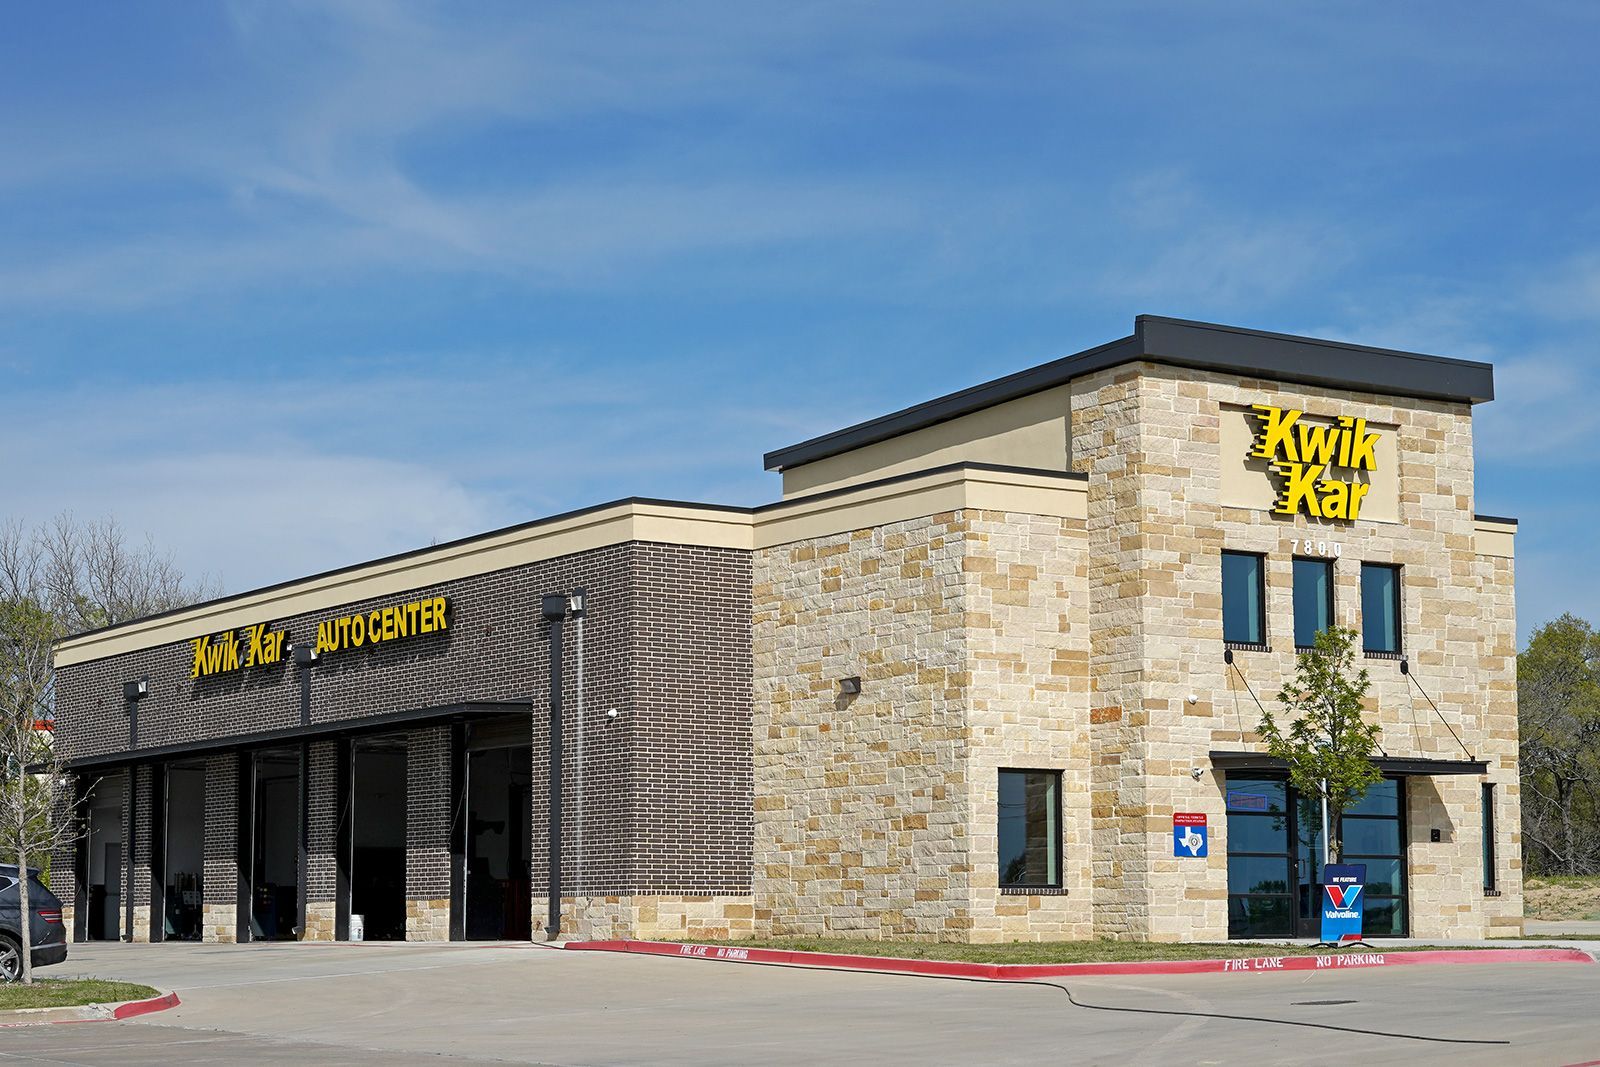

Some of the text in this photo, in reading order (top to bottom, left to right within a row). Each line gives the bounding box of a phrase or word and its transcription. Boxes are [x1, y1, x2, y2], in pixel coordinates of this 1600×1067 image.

[1251, 404, 1382, 471] Kwik
[1271, 461, 1369, 520] Kar
[1290, 539, 1342, 558] 7800
[189, 597, 447, 679] Kwik Kar AUTO CENTER
[1224, 954, 1384, 971] FIRE LANE NO PARKING
